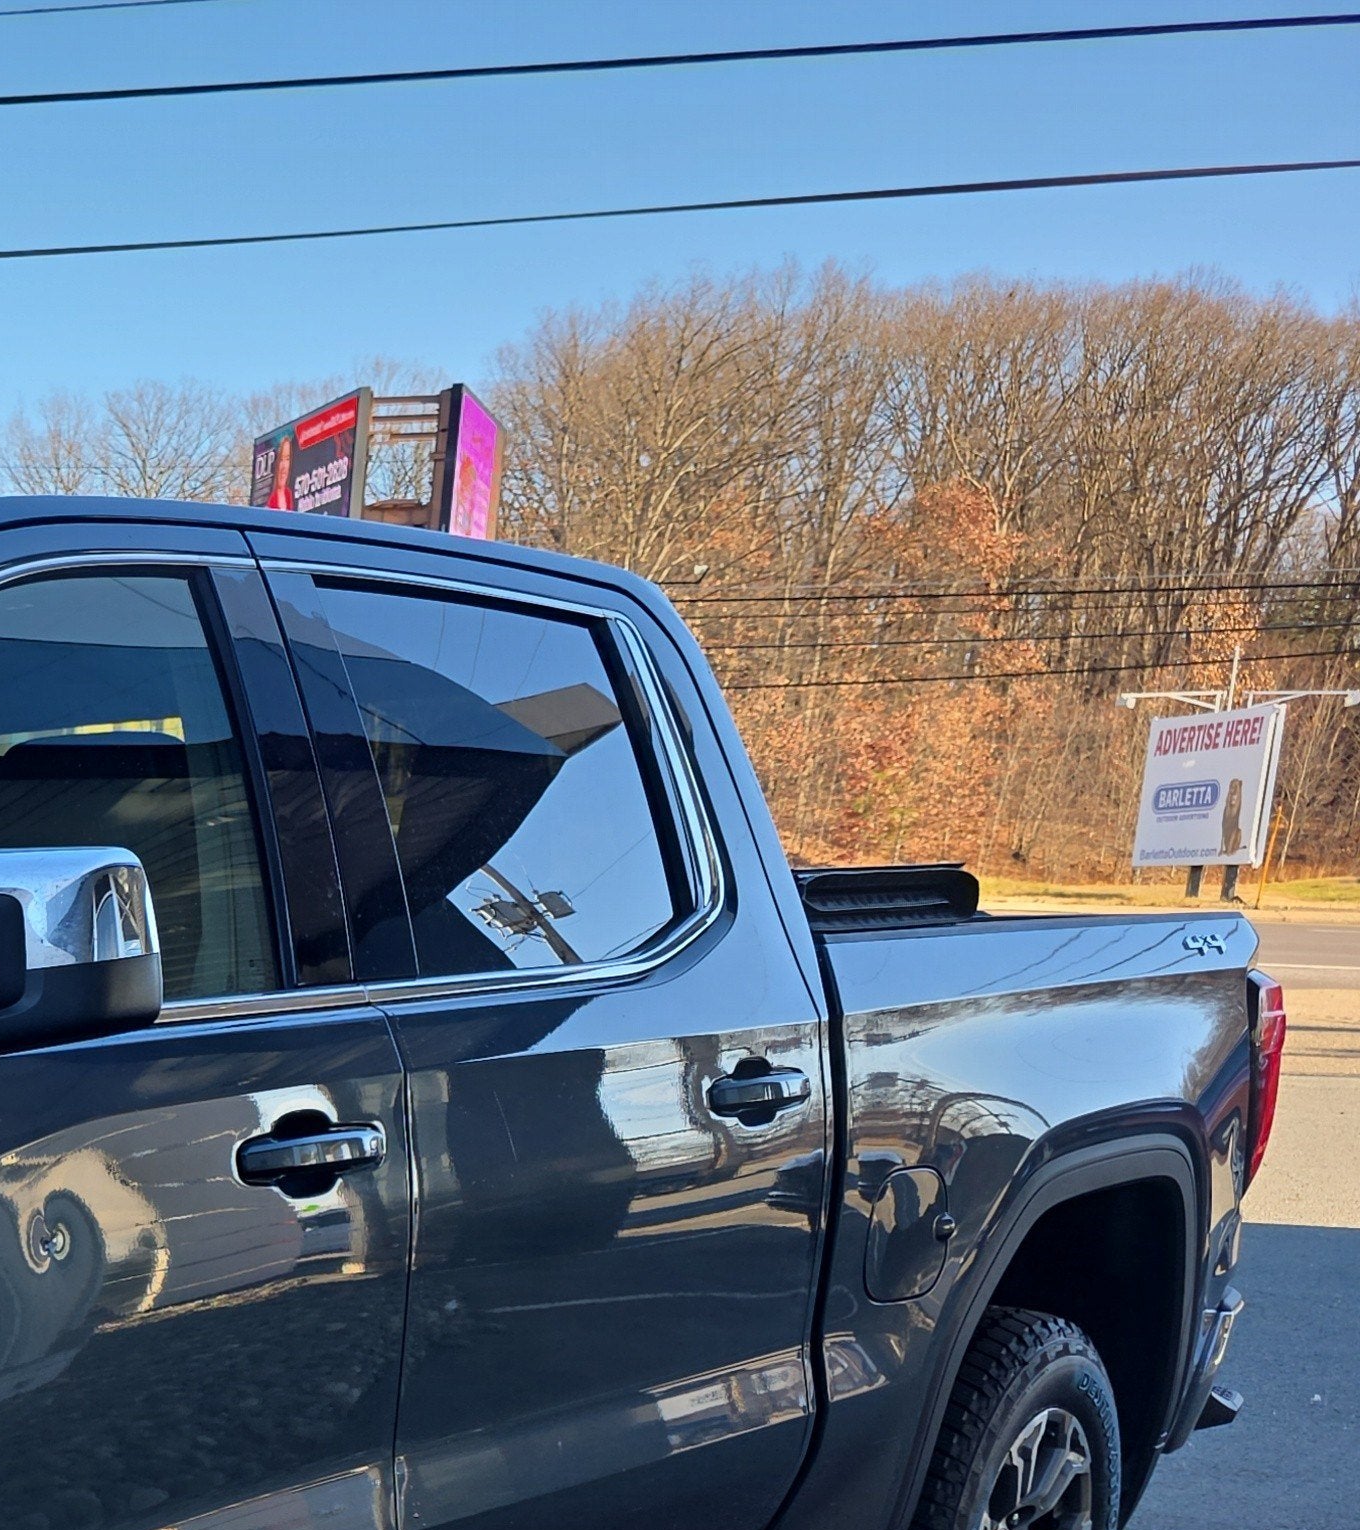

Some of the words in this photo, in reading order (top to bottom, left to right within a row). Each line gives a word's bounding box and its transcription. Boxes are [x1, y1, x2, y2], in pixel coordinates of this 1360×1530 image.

[1154, 722, 1223, 757] ADVERTISE
[1223, 716, 1265, 749] HERE!
[1157, 785, 1212, 809] BARLETTA
